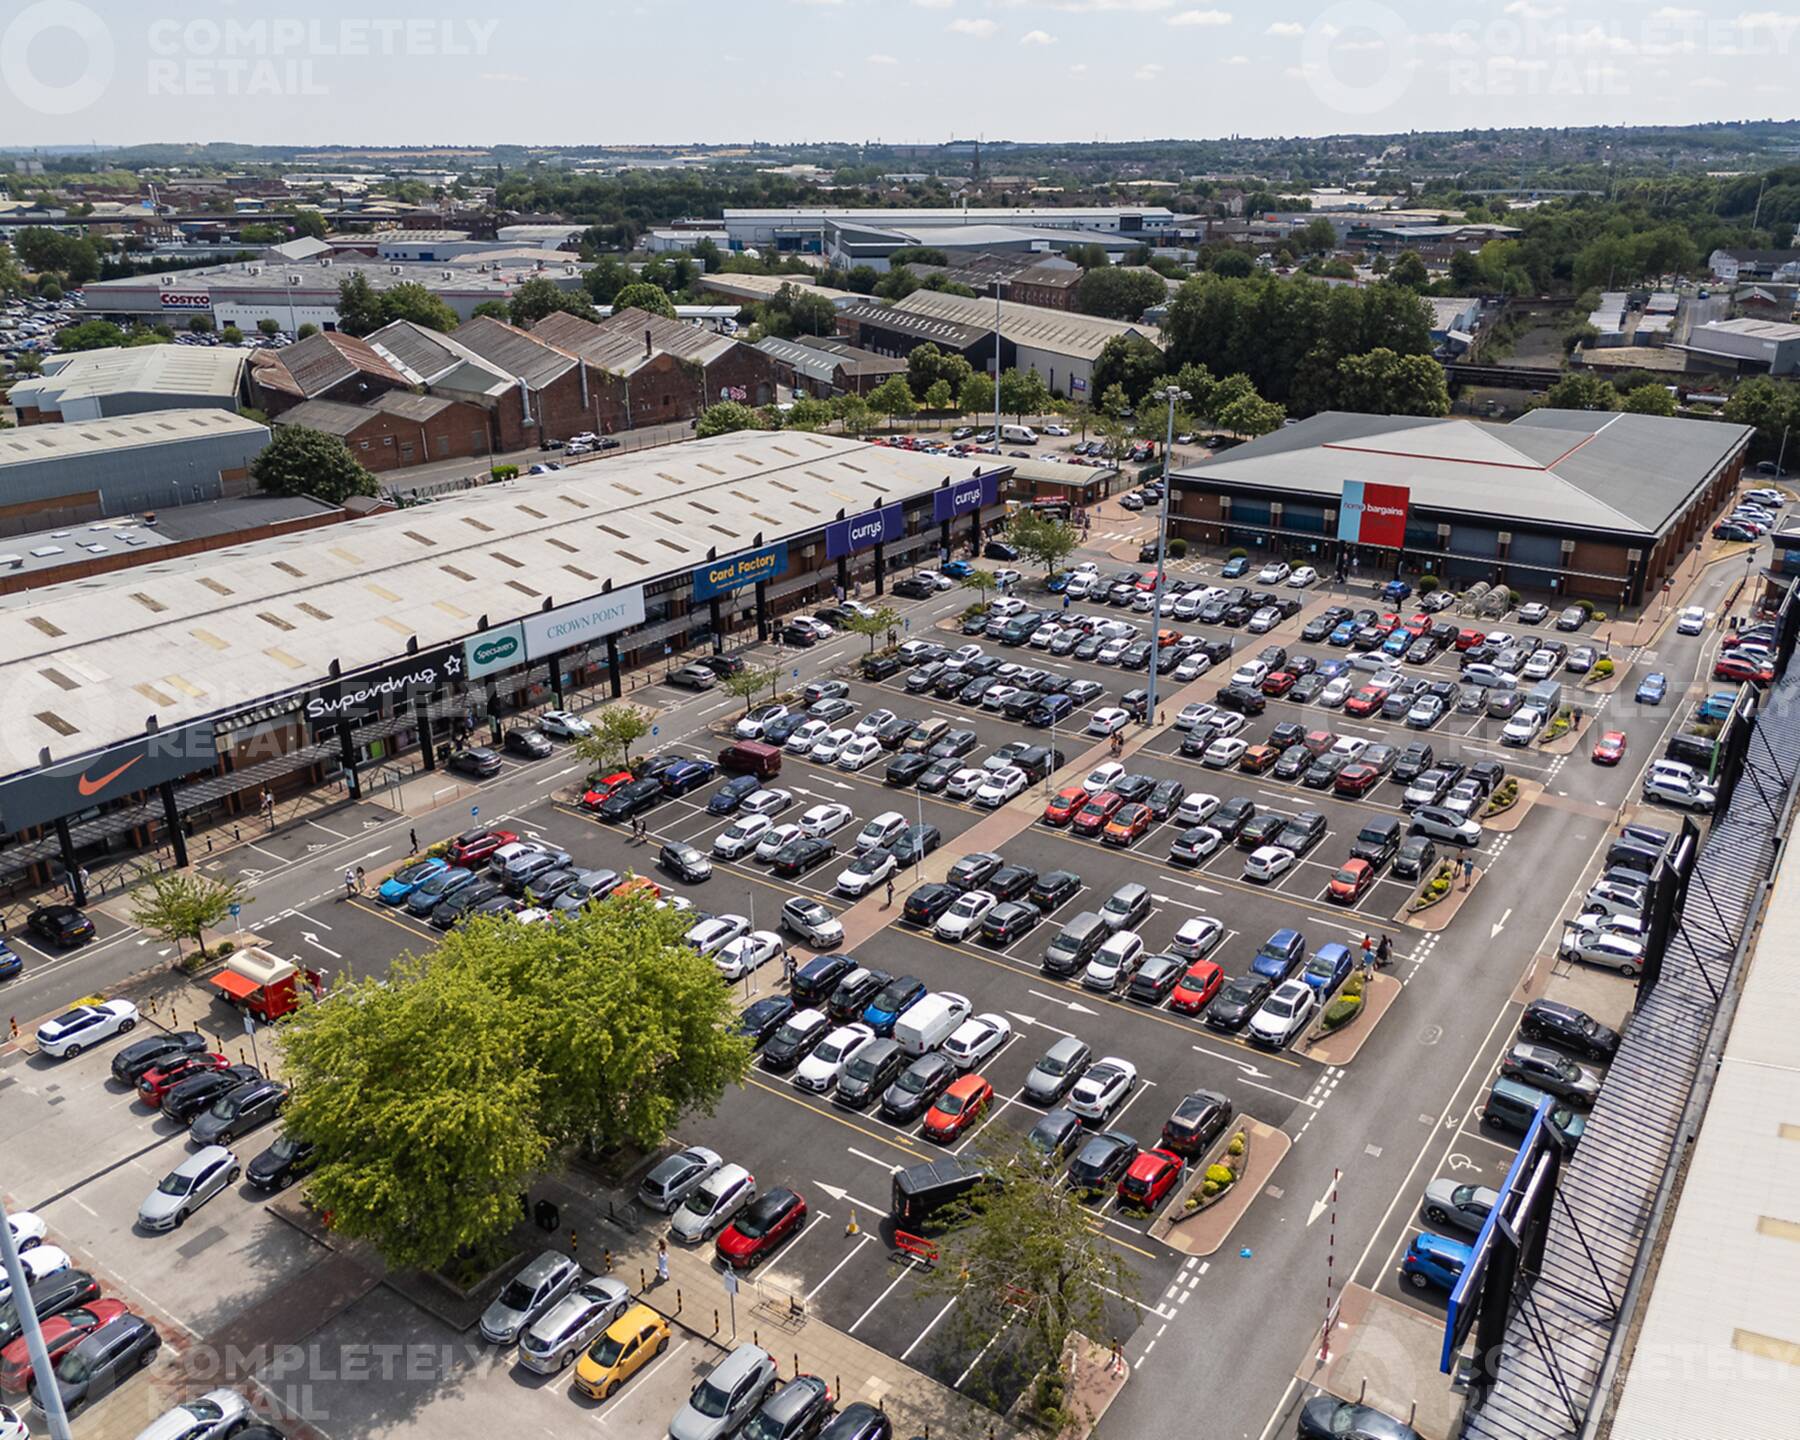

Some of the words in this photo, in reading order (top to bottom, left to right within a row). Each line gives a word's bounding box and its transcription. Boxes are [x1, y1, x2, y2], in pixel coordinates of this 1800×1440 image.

[955, 488, 981, 506] currys
[1367, 504, 1404, 516] bargains
[851, 520, 882, 540] currys
[709, 565, 734, 583] Card
[738, 553, 776, 574] Factory
[546, 614, 591, 640] CROWN
[591, 603, 627, 625] POINT
[476, 641, 515, 660] Specsavers
[306, 667, 438, 718] Superdrug
